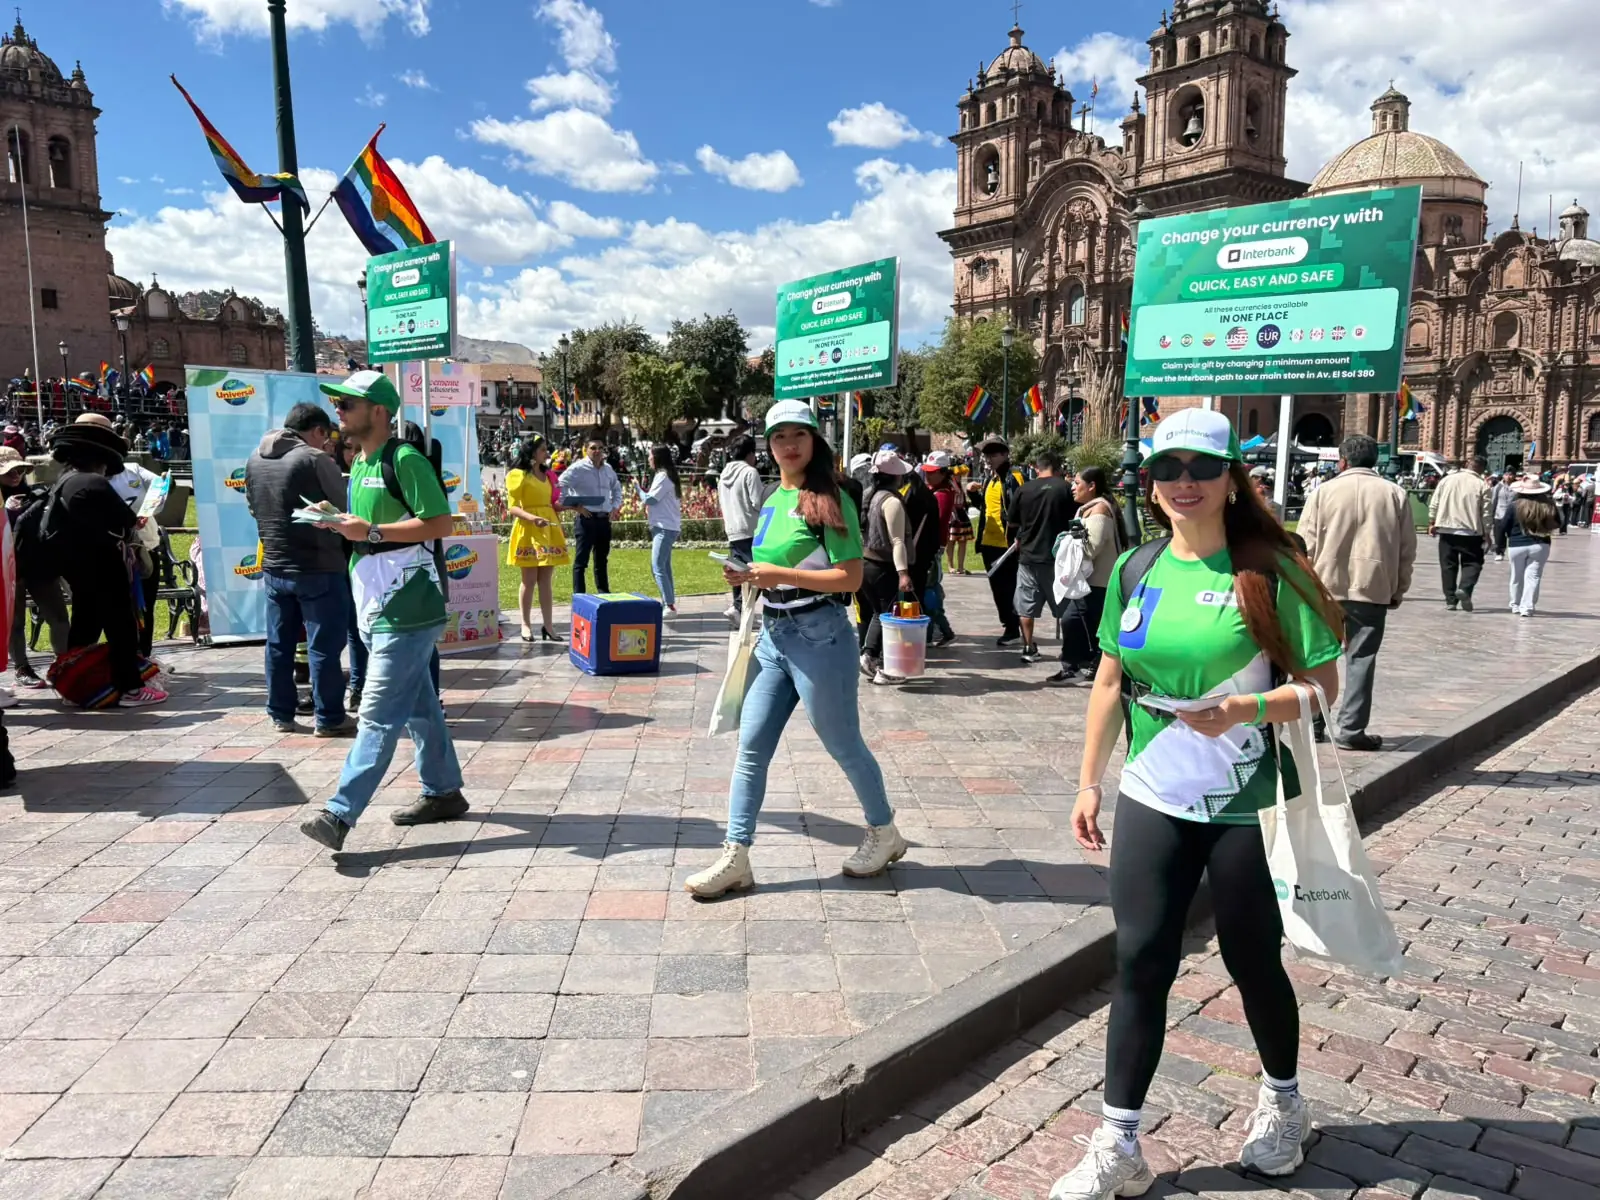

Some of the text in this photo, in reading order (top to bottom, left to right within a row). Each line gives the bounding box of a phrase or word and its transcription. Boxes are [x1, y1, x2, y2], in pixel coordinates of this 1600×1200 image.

[1161, 207, 1384, 246] Change your currency with
[1242, 245, 1296, 260] Interbank
[787, 270, 882, 301] Change your currency with
[1189, 269, 1334, 294] QUICK, EASY AND SAFE
[1214, 305, 1233, 313] these
[1234, 303, 1272, 312] currencies
[1273, 301, 1308, 310] available
[820, 318, 835, 327] EASY
[835, 314, 848, 324] AND
[848, 311, 863, 321] SAFE
[1219, 311, 1289, 324] IN ONE PLACE
[1258, 330, 1279, 342] EUR
[1161, 362, 1183, 370] Claim
[1183, 362, 1201, 371] your
[1201, 361, 1215, 370] gift
[1215, 360, 1226, 369] by
[1226, 359, 1264, 369] changing
[1272, 357, 1314, 366] minimum
[1314, 356, 1350, 365] amount
[1141, 375, 1164, 383] Follow
[1177, 374, 1214, 382] Interbank
[1215, 373, 1234, 383] path
[1259, 372, 1281, 380] main
[1306, 370, 1315, 379] in
[1316, 370, 1332, 378] Av.
[1341, 369, 1356, 378] Sol
[1357, 369, 1375, 378] 380
[215, 387, 255, 399] Universal
[1174, 428, 1210, 440] Interbank
[1302, 888, 1352, 903] nterbank
